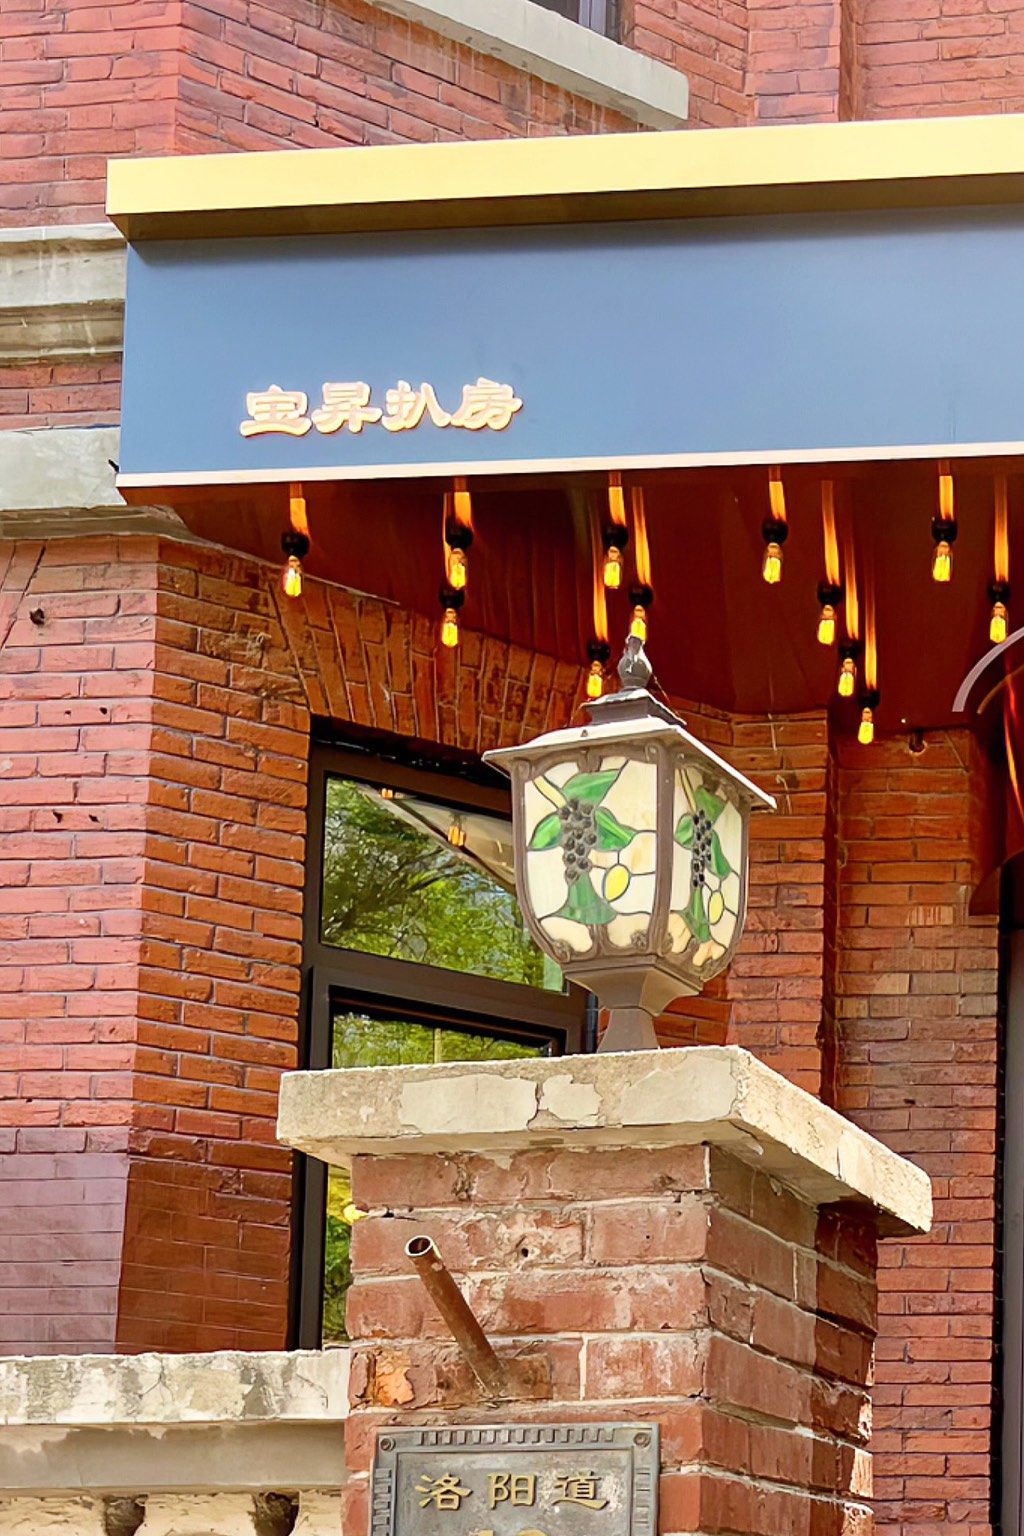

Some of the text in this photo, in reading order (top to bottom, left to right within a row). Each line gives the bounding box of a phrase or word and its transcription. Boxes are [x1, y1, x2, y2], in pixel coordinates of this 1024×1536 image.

[239, 376, 523, 437] 宝昇扒房
[414, 1470, 610, 1511] 洛阳道
